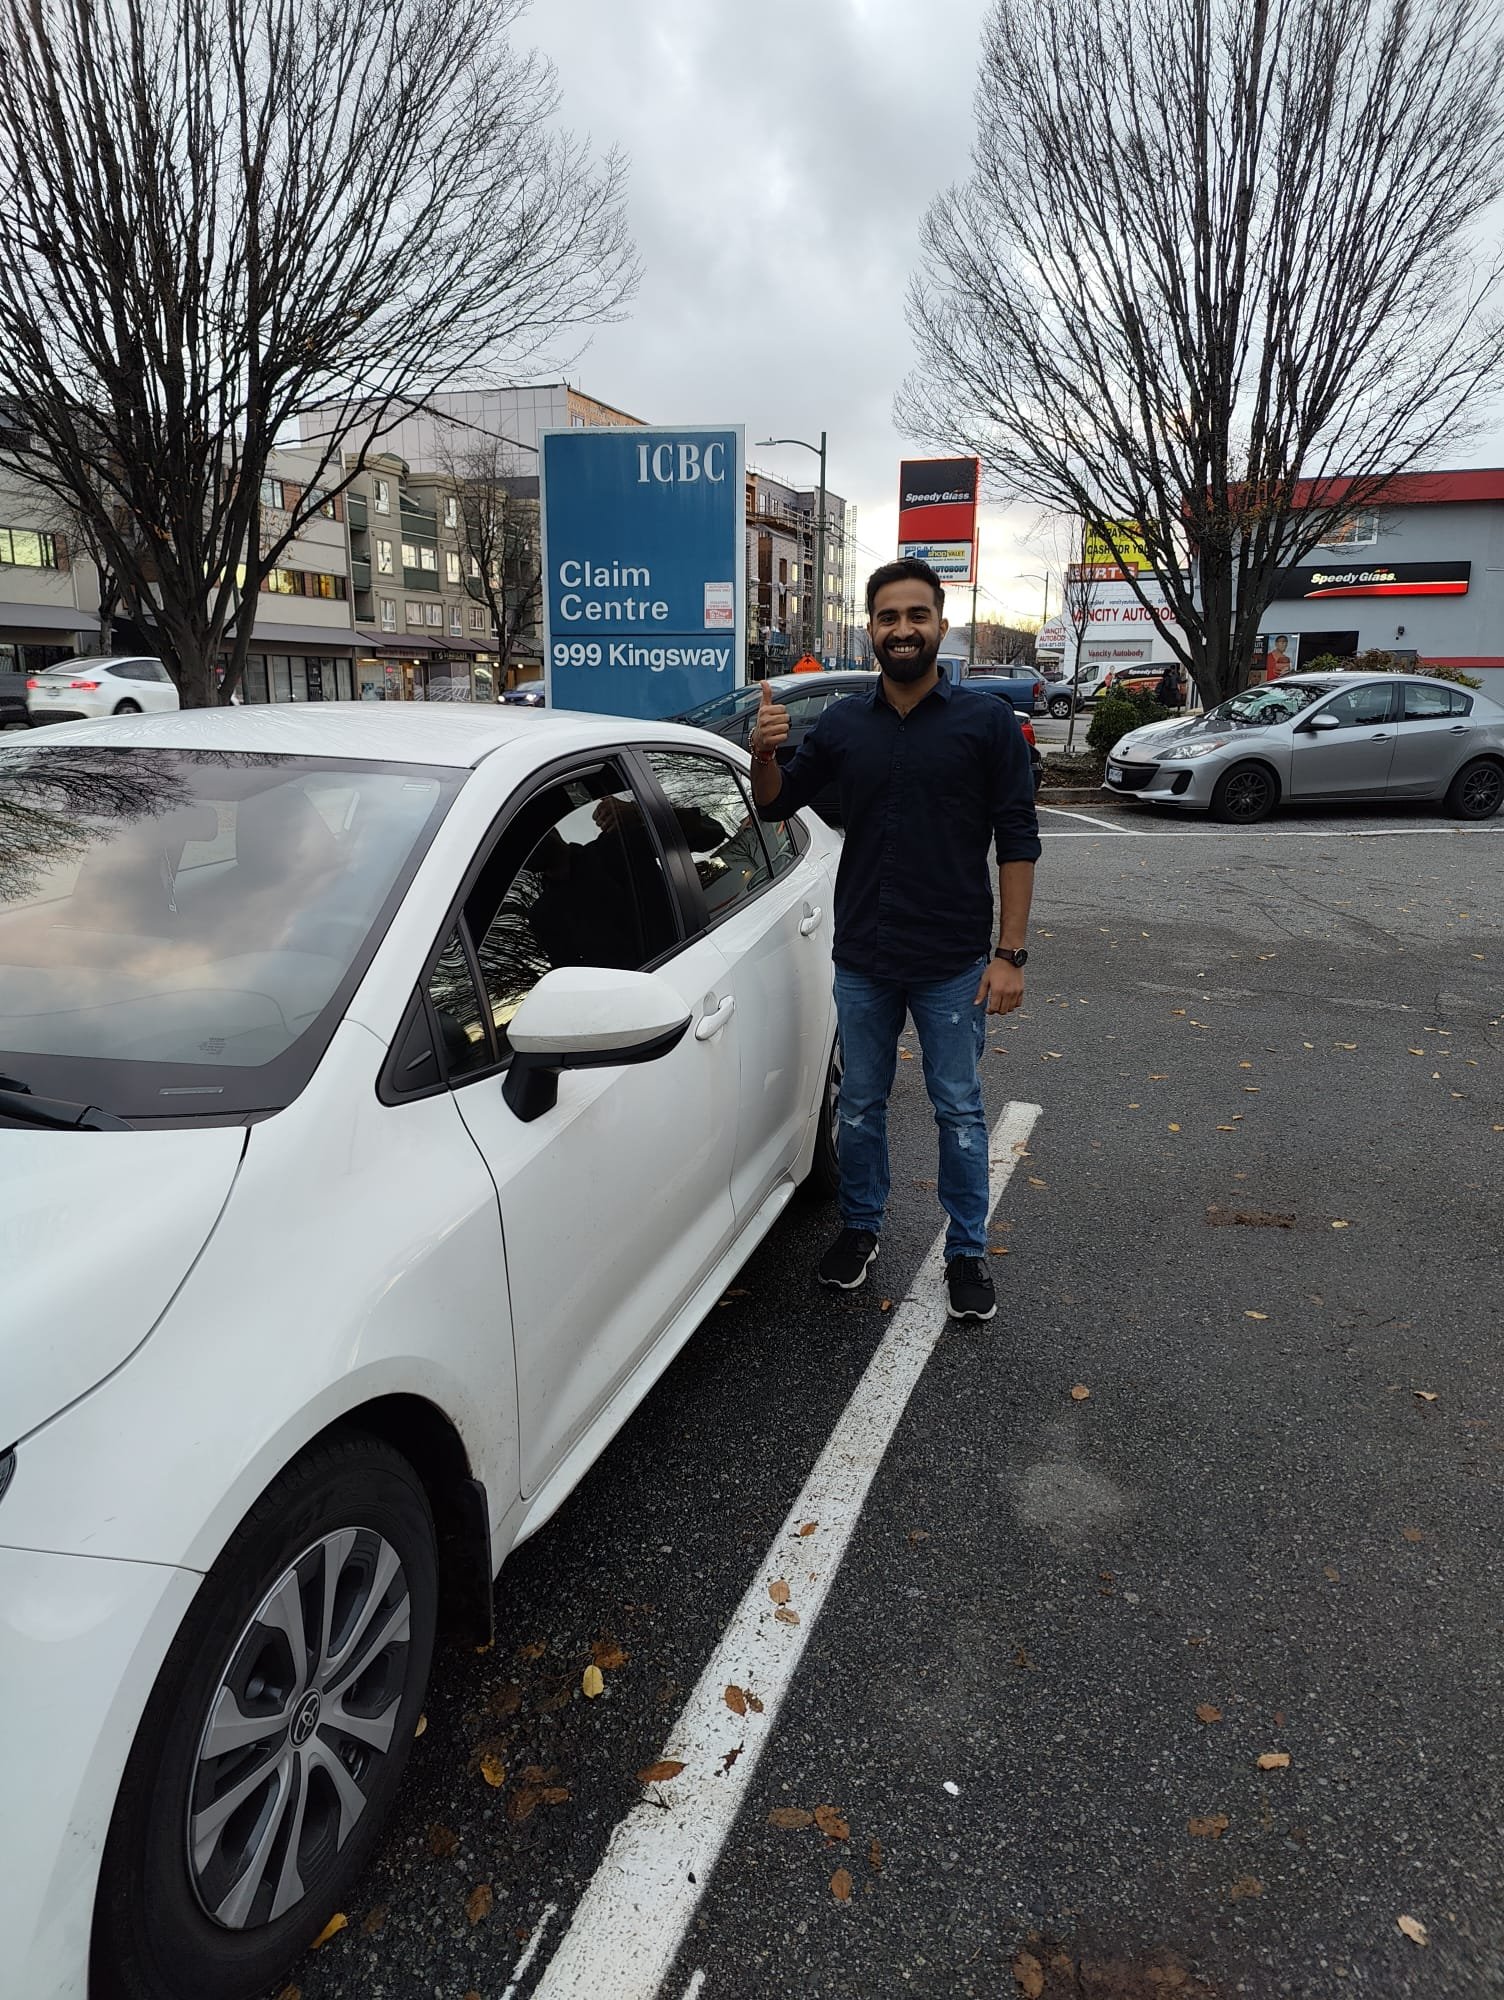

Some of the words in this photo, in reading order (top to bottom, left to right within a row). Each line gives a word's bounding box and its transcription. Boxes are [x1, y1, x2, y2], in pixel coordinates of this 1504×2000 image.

[636, 442, 726, 484] ICBC
[905, 492, 942, 504] Speedy
[559, 560, 650, 588] Claim
[1310, 572, 1359, 585] Speedy
[560, 594, 669, 621] Centre
[1122, 606, 1178, 622] AUTOBOD
[553, 643, 602, 667] 999
[609, 643, 730, 672] Kingsway
[1088, 649, 1112, 658] Vancity
[1112, 648, 1145, 658] Autobody
